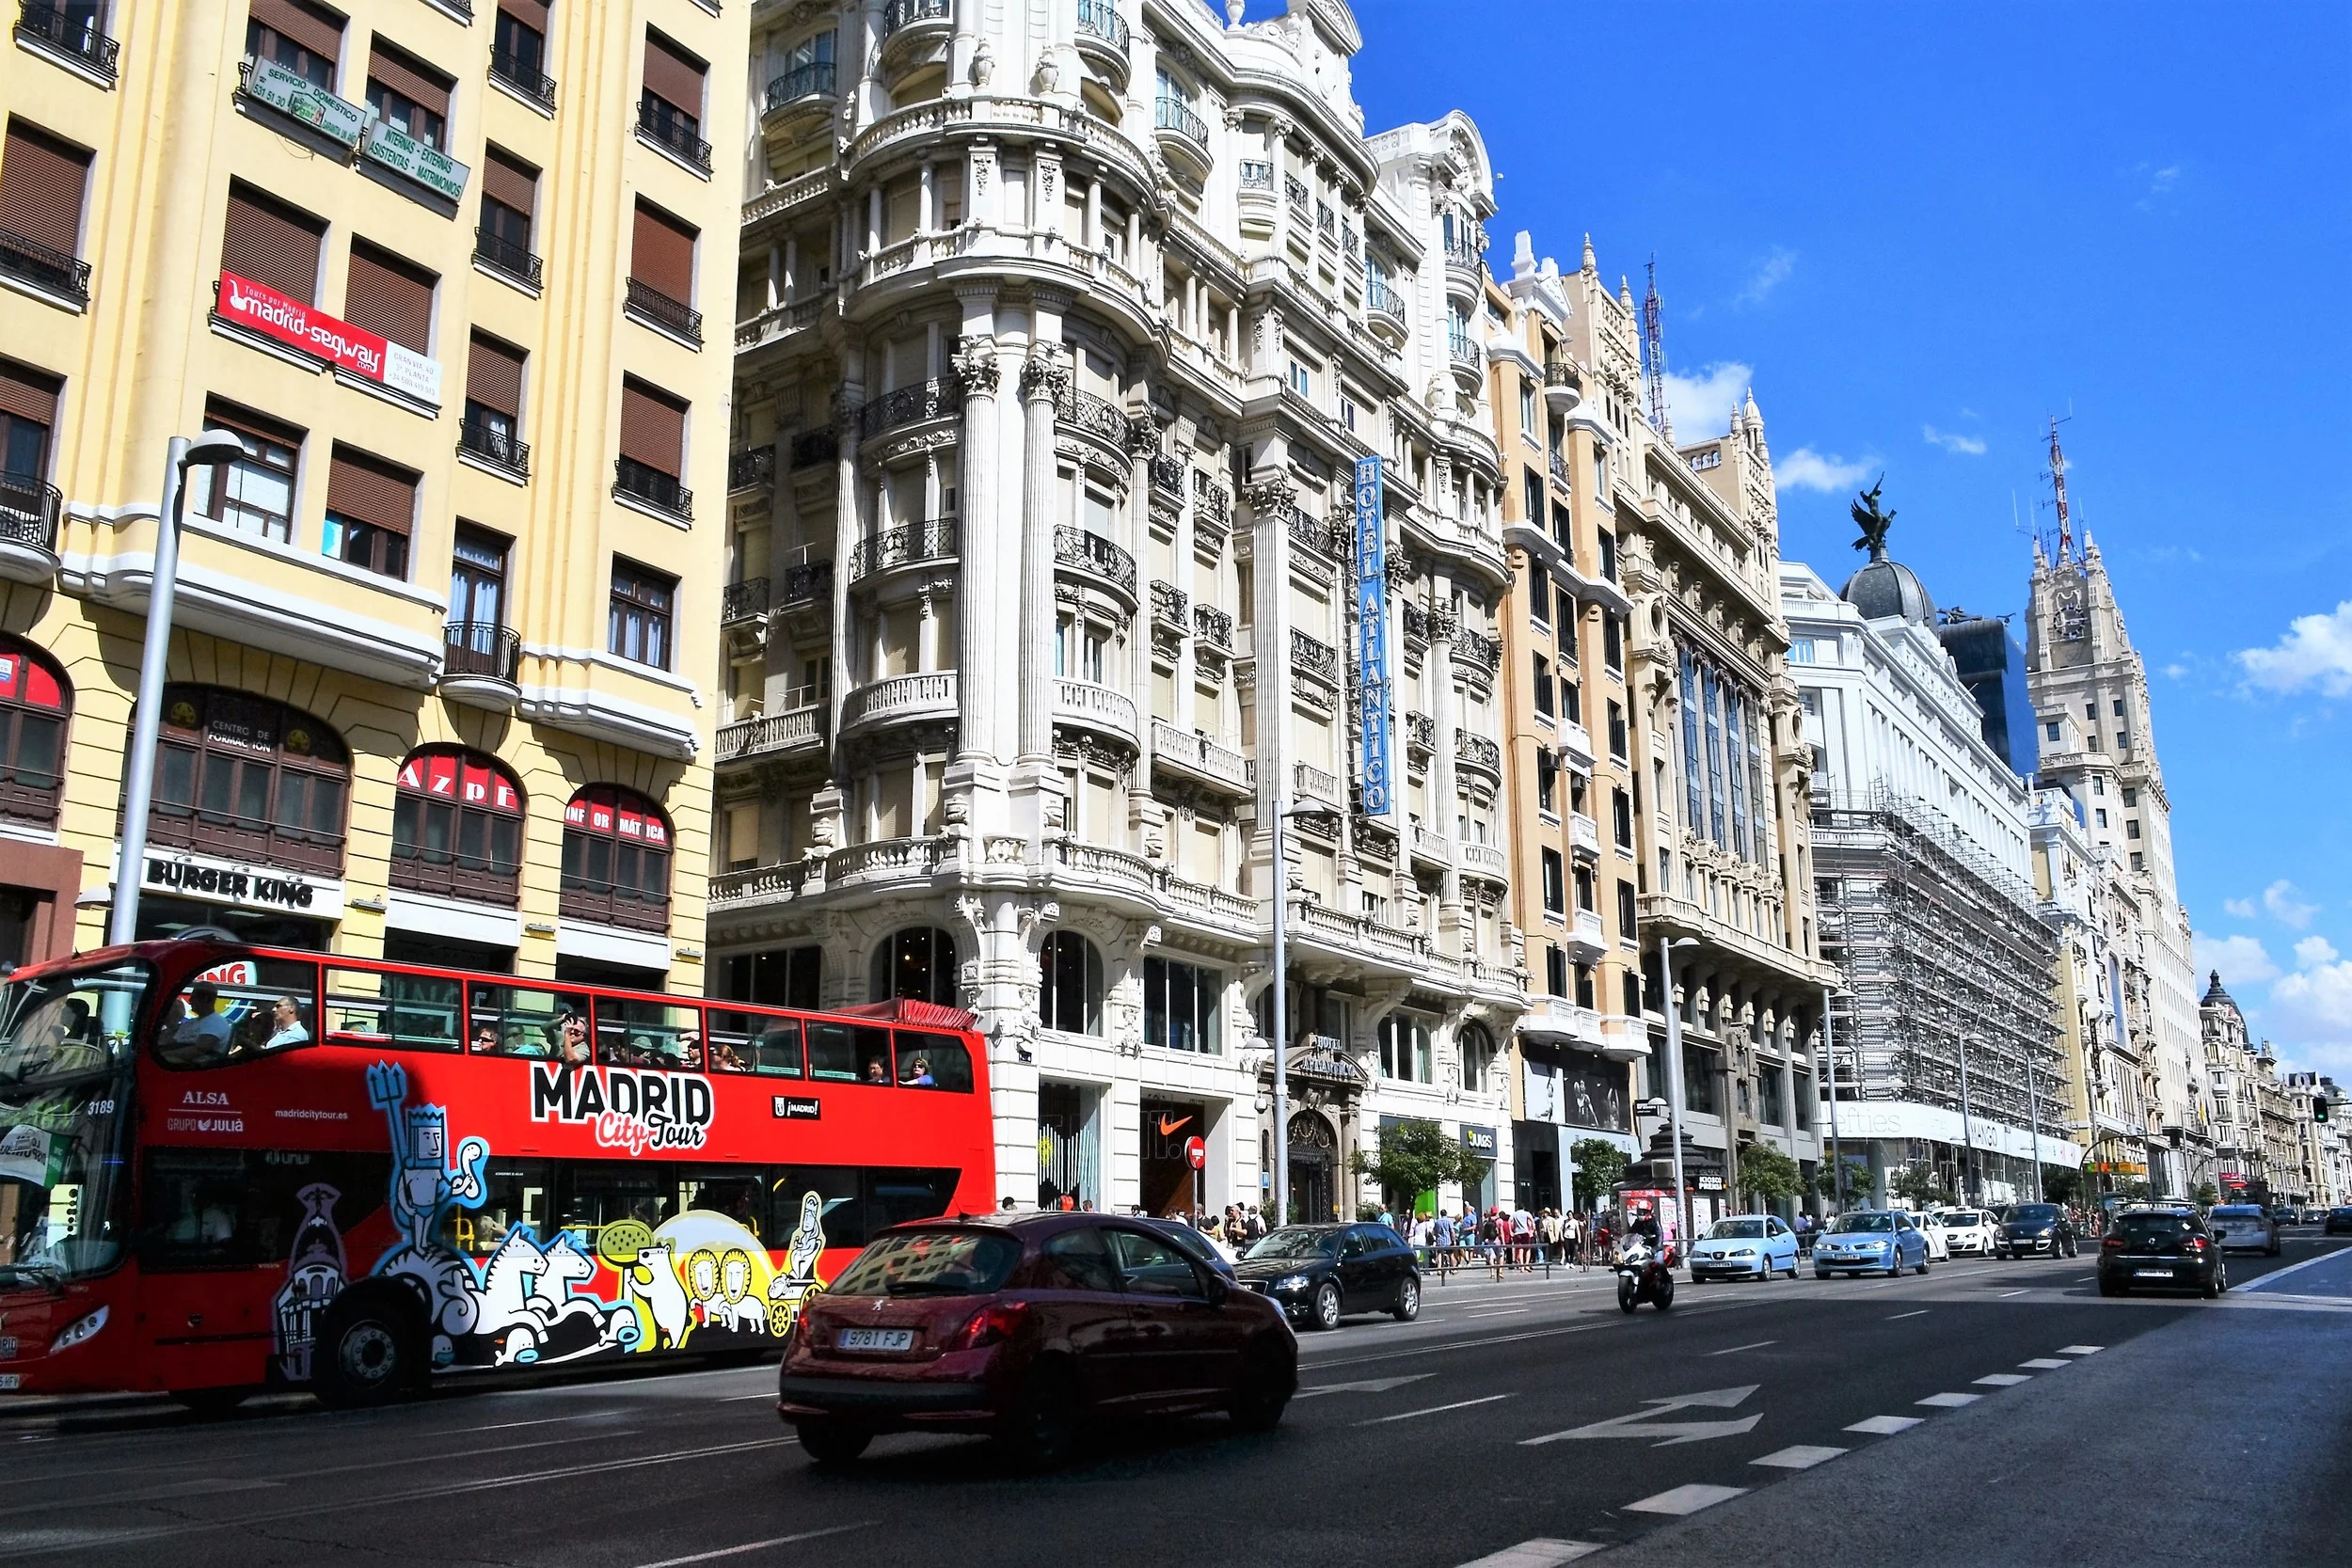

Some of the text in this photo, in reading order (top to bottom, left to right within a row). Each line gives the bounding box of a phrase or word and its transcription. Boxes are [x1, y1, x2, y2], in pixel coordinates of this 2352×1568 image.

[252, 84, 286, 107] 531 51 30
[268, 69, 358, 122] SERVICIO DOMESTICO
[385, 129, 453, 174] INTERNAS EXTERNAS
[369, 140, 462, 197] ASISTENTAS MATRIMONIOS
[245, 285, 307, 318] Tours por Madrid
[1359, 463, 1379, 578] HOTEL
[1361, 593, 1384, 810] ATLANTICO
[213, 721, 270, 740] CENTRO DE
[147, 858, 313, 909] BURGER KING
[87, 1100, 115, 1116] 3189
[183, 1091, 230, 1105] ALSA
[532, 1066, 712, 1127] MADRID
[167, 1118, 197, 1132] GRUPO
[275, 1108, 348, 1120] madridcitytour.es
[1824, 1106, 1902, 1133] lefties
[597, 1111, 704, 1150] City Tour
[1969, 1121, 1998, 1148] MANGO
[0, 1337, 17, 1351] RID
[849, 1331, 909, 1347] 9781 FJP
